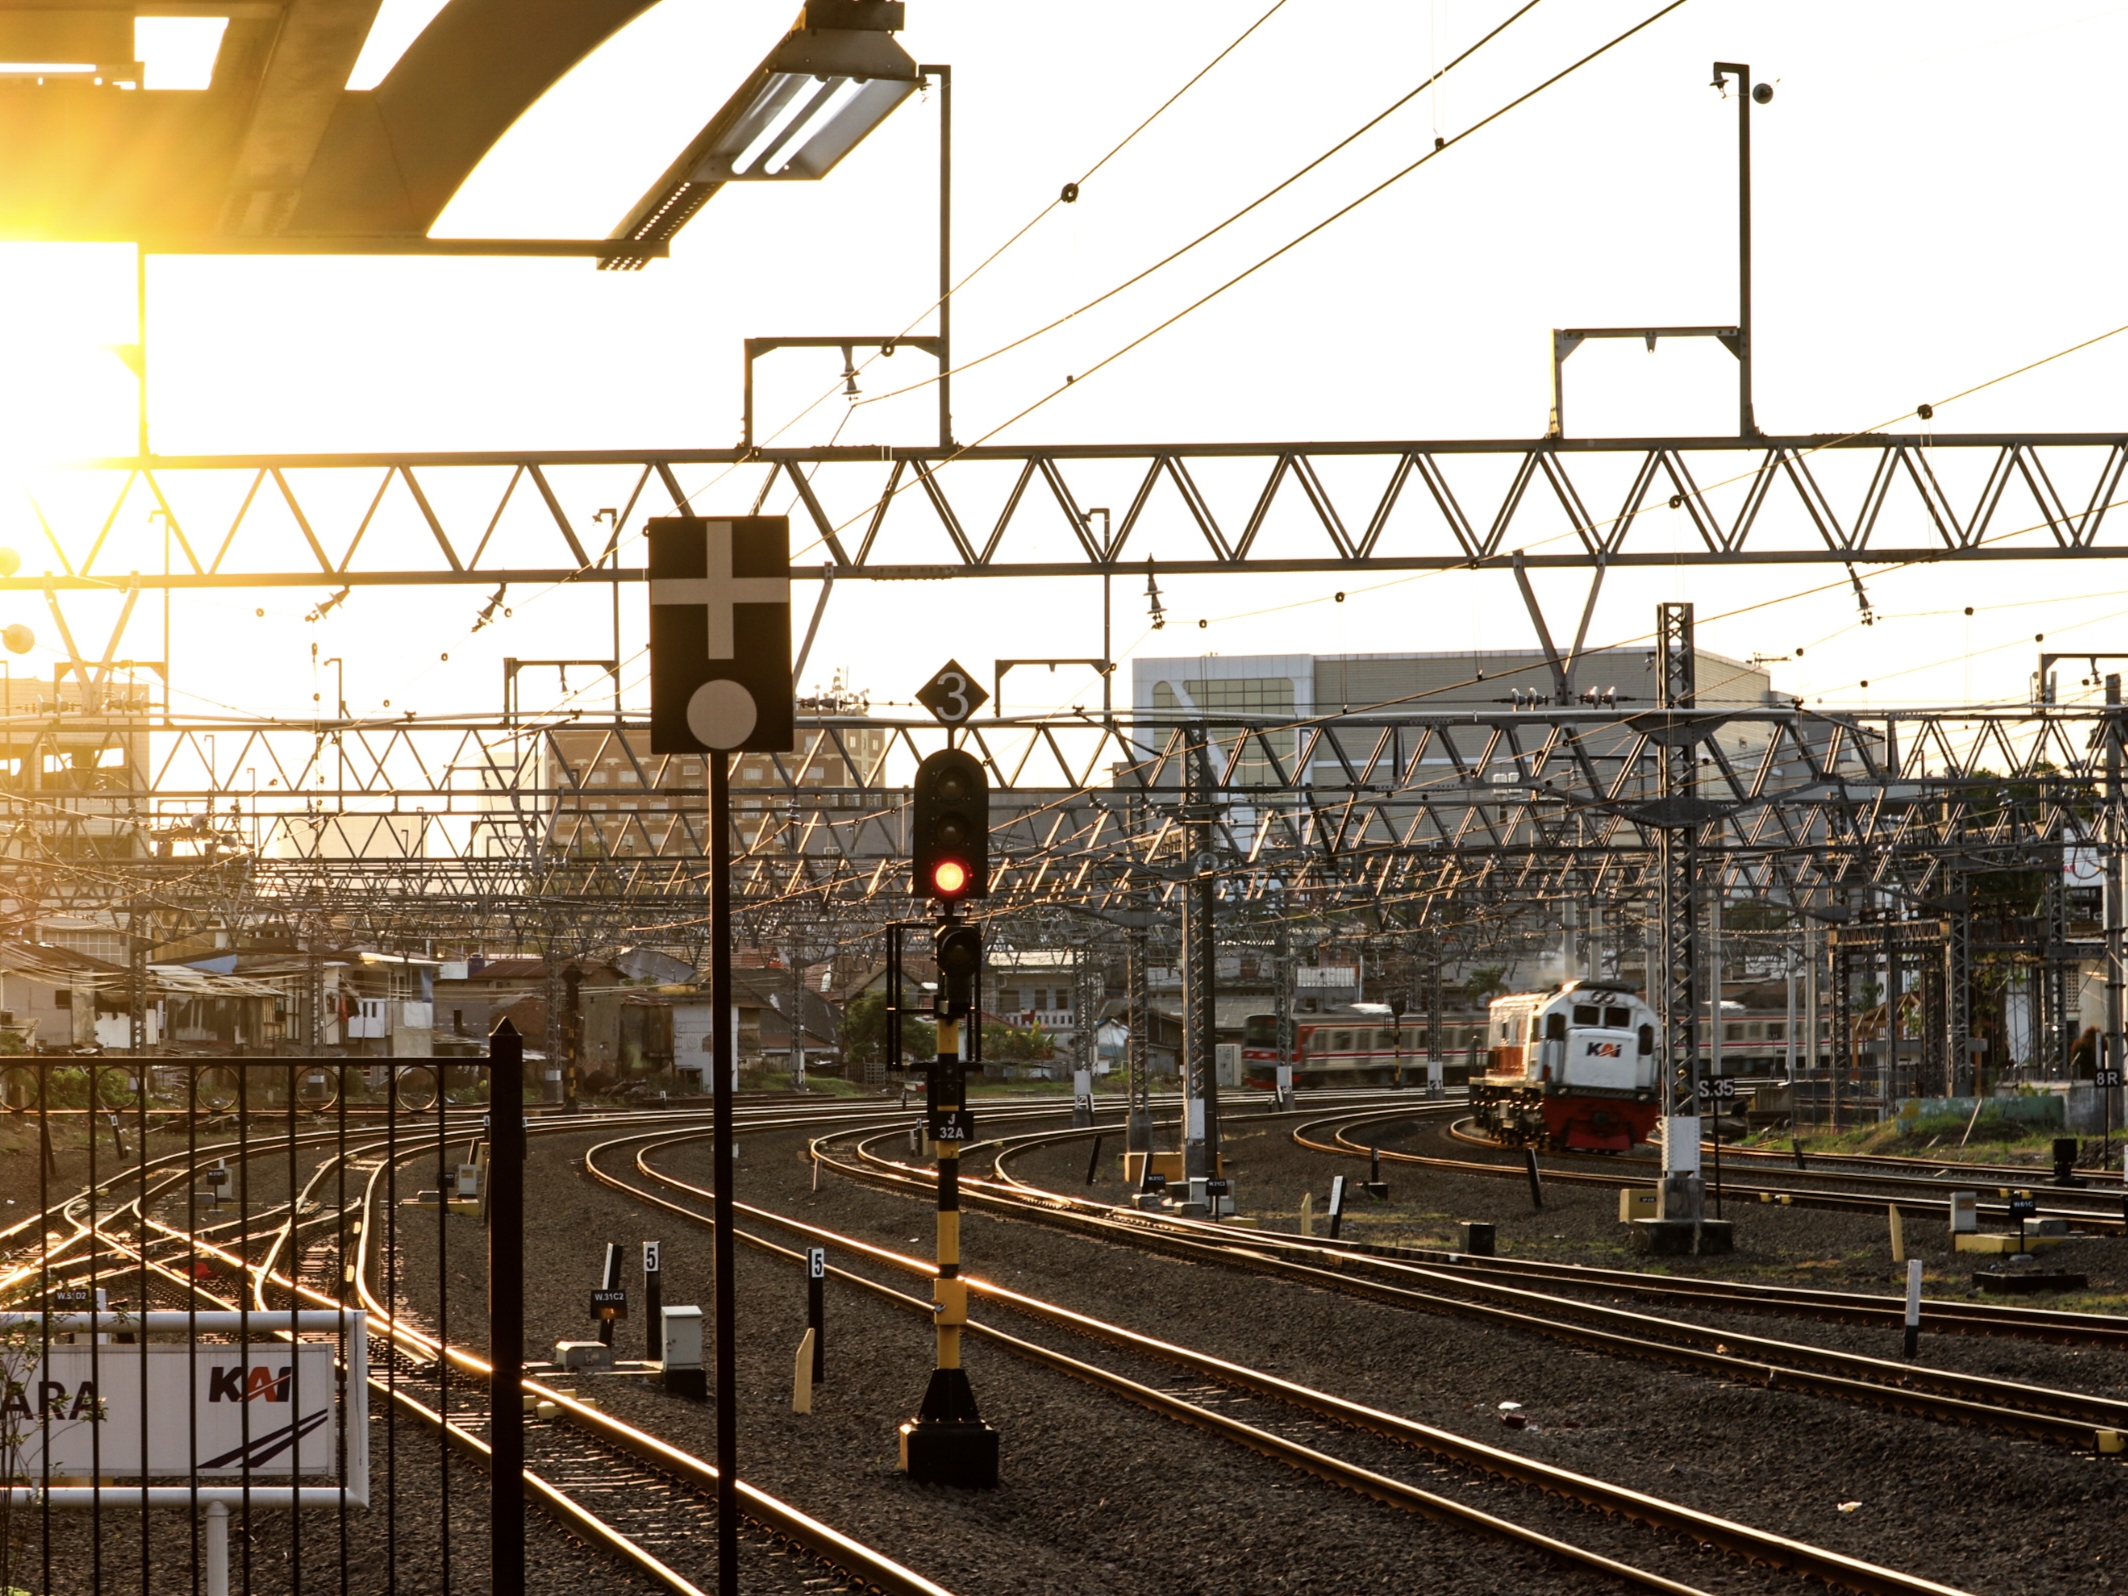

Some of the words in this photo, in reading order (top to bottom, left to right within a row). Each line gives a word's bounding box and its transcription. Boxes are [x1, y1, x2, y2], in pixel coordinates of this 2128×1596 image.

[936, 671, 969, 722] 3
[1698, 1079, 1734, 1098] S.35
[947, 1113, 956, 1125] J
[939, 1127, 965, 1139] 32A
[646, 1247, 656, 1270] 5
[814, 1253, 823, 1276] 5
[594, 1292, 625, 1301] W.31C2
[208, 1366, 292, 1403] KAI
